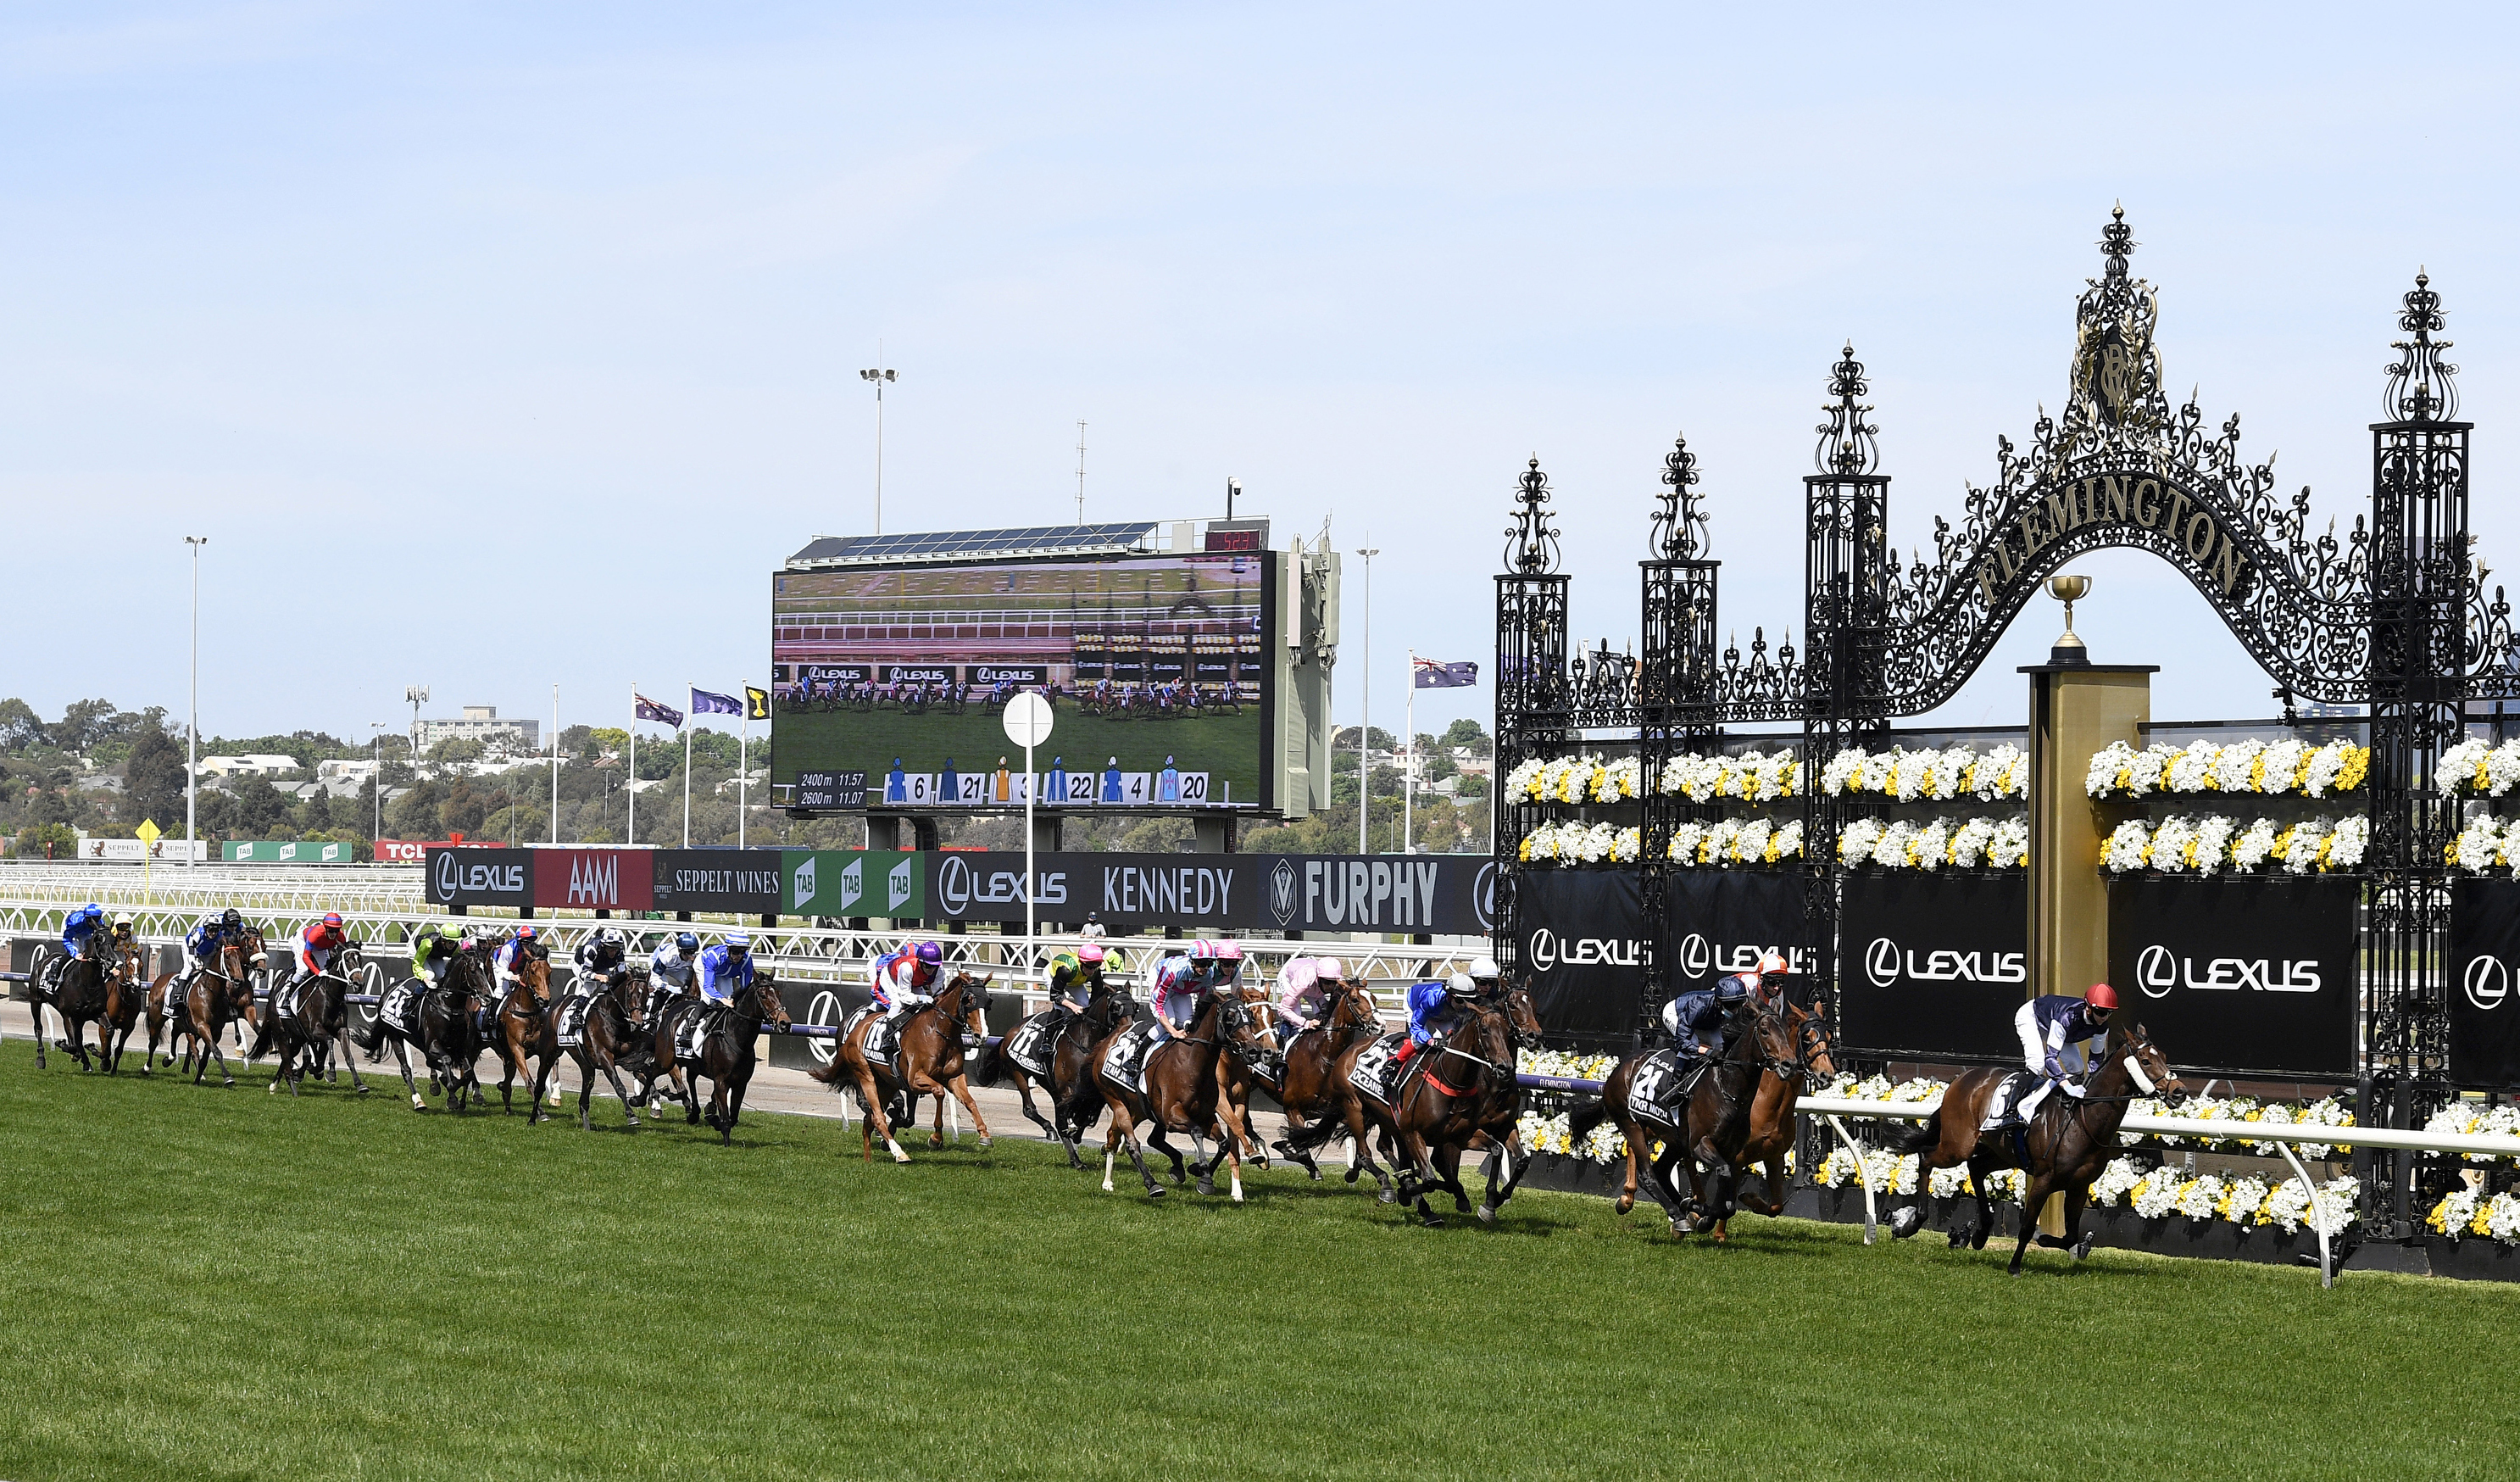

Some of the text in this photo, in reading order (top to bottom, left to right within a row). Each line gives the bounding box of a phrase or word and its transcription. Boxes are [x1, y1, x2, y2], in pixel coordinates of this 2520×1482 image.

[1975, 475, 2247, 610] FLEMINGTON
[821, 668, 860, 680] LEXUS
[903, 669, 944, 681] LEXUS
[992, 669, 1035, 681] LEXUS
[838, 773, 864, 787] 11.57
[915, 777, 925, 800] 6
[963, 777, 981, 799] 21
[1070, 776, 1091, 799] 22
[1131, 776, 1142, 800] 4
[1182, 776, 1204, 799] 20
[838, 791, 863, 805] 11.07
[386, 844, 426, 859] TCL
[459, 865, 524, 891] LEXUS
[567, 854, 617, 905] AAMI
[654, 885, 672, 894] SEPPELT
[676, 869, 779, 894] SEPPELT WINES
[796, 874, 814, 894] TAB
[843, 874, 860, 894] TAB
[891, 875, 909, 895] TAB
[972, 872, 1067, 904] LEXUS
[1104, 866, 1233, 916] KENNEDY
[1305, 861, 1438, 926] FURPHY
[1906, 949, 2026, 983] LEXUS
[2183, 957, 2321, 993] LEXUS
[1104, 1061, 1120, 1078] ETAH
[1539, 1078, 1572, 1089] FLEMINGTON
[1633, 1064, 1663, 1102] 21
[1991, 1084, 2011, 1118] 6
[1649, 1105, 1668, 1121] MOTH
